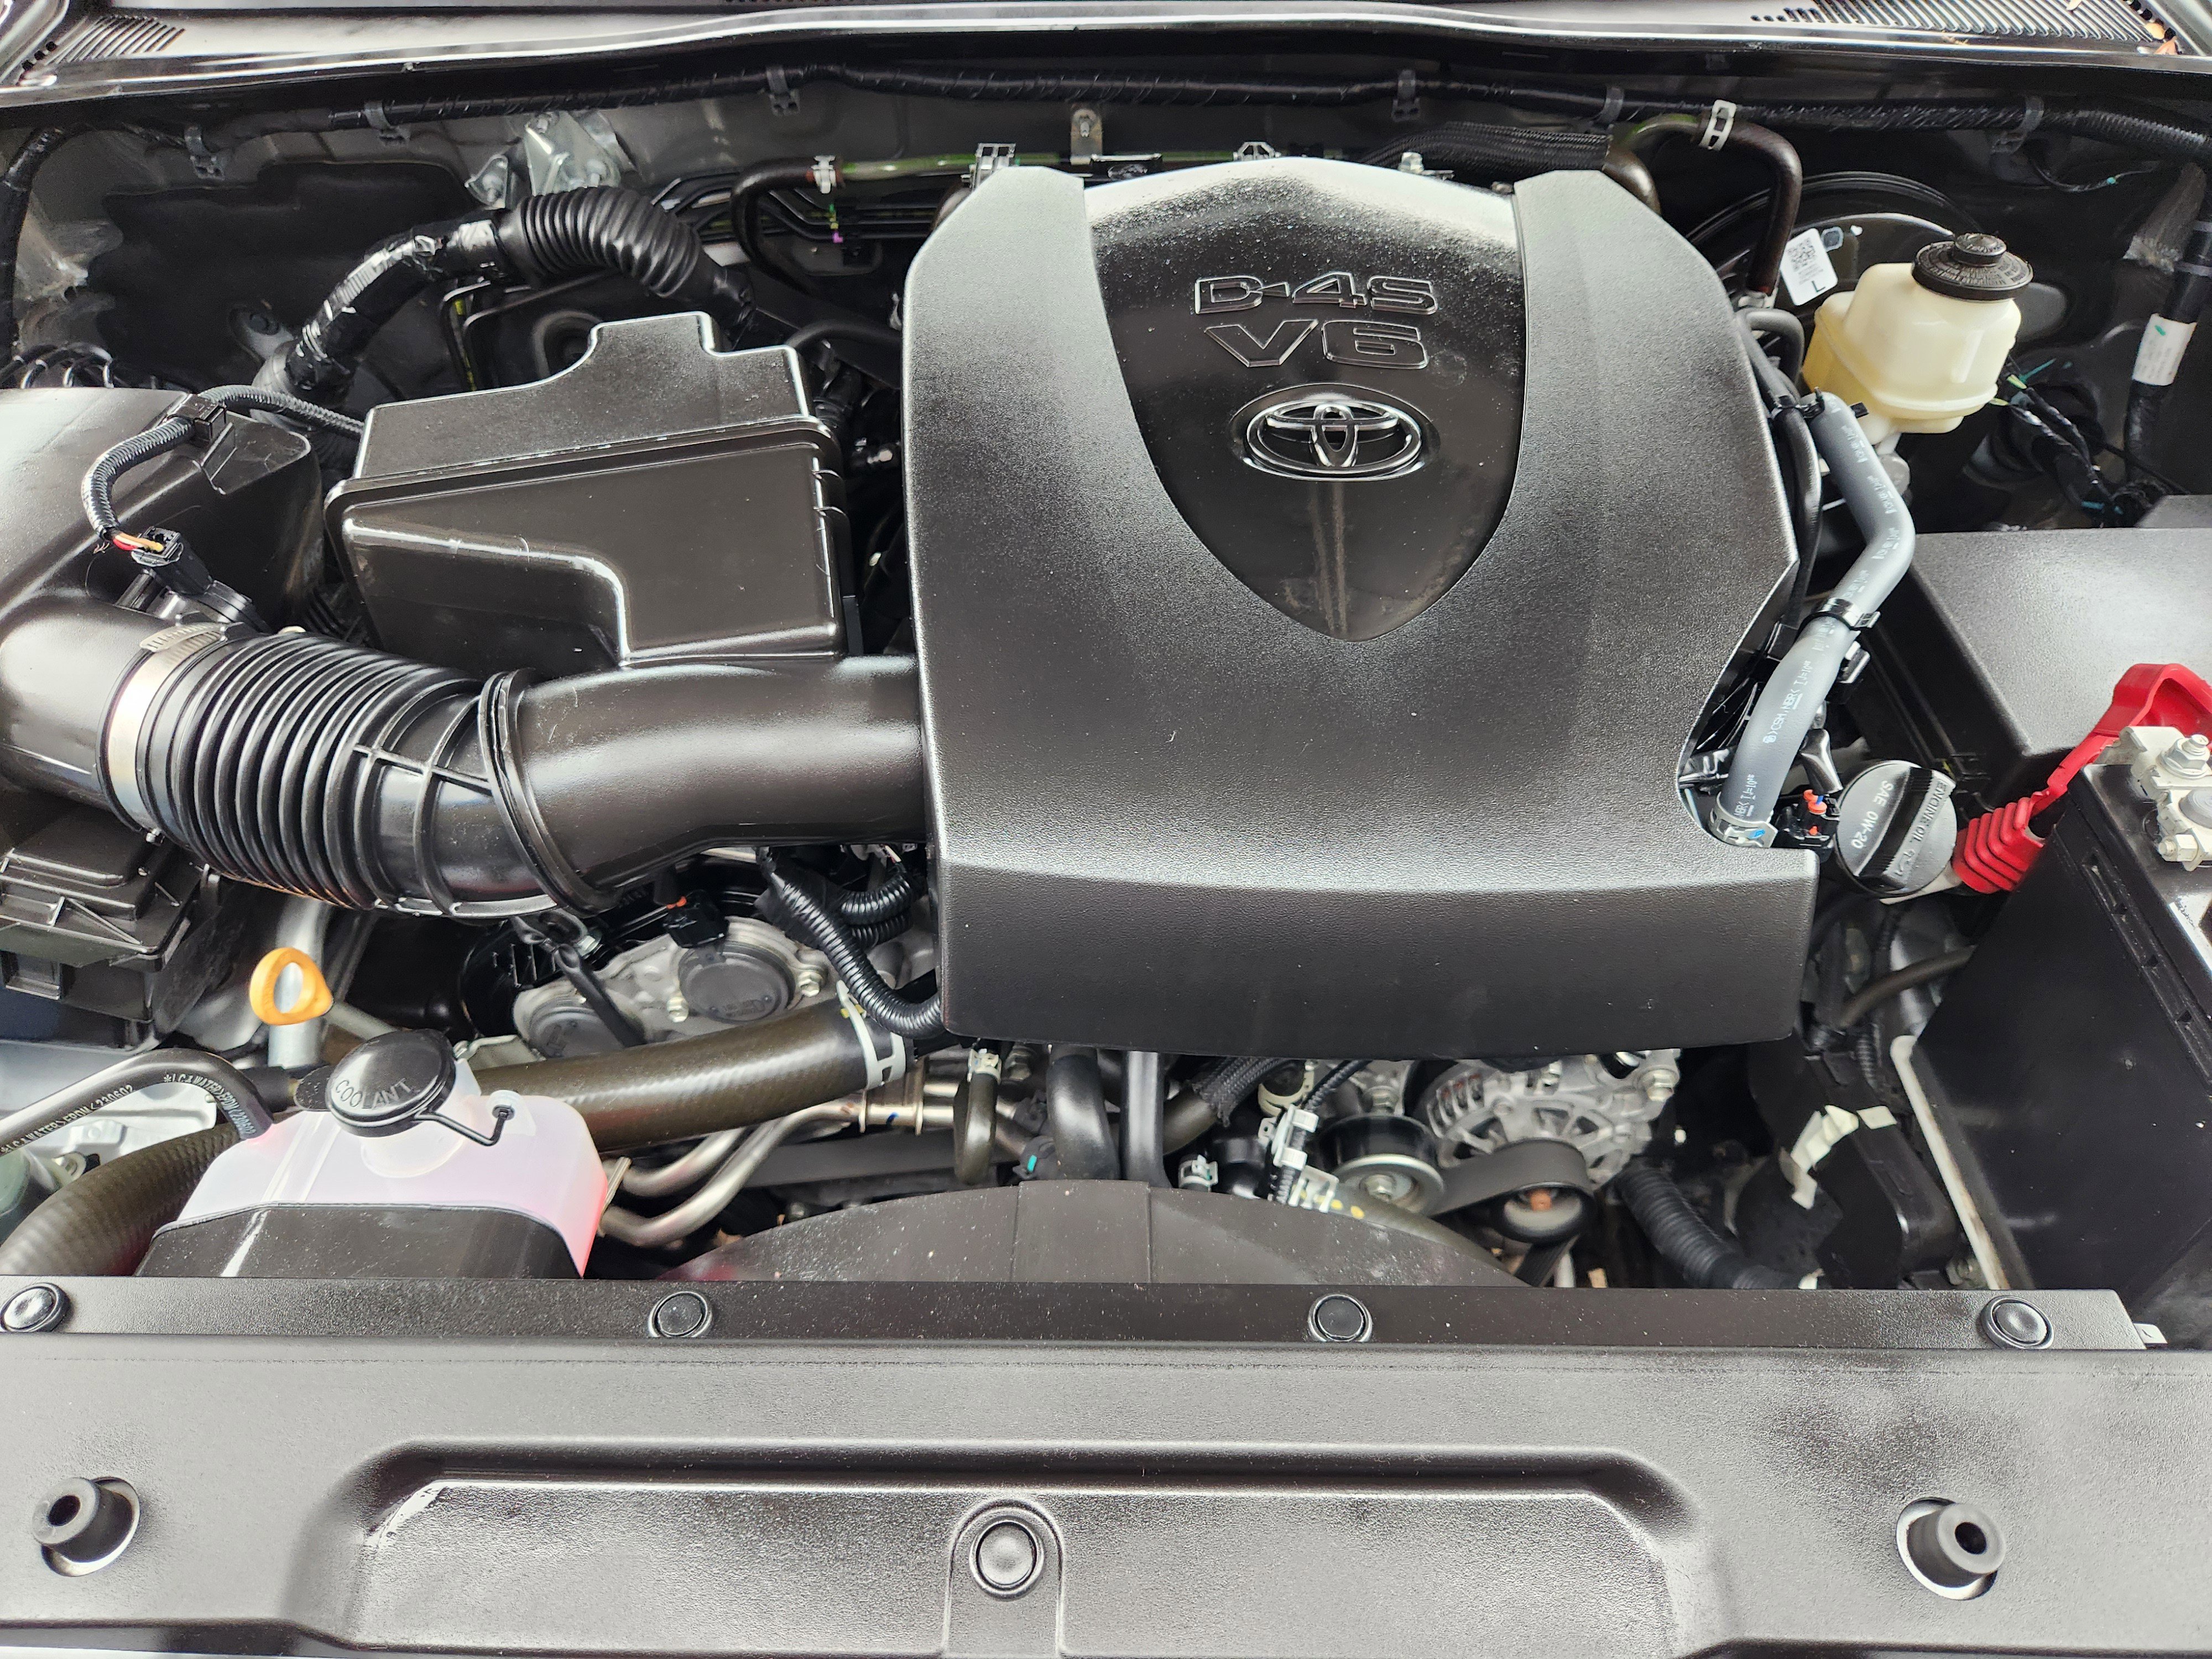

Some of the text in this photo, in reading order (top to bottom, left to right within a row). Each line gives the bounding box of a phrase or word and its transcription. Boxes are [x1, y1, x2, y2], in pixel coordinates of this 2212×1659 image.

[1194, 270, 1439, 315] D-4S
[1812, 280, 1827, 293] L
[1203, 319, 1429, 369] V6
[1851, 780, 1894, 849] SAE 0W-20
[1911, 779, 1947, 842] ENGINE OIL
[336, 1078, 411, 1109] COOLANT
